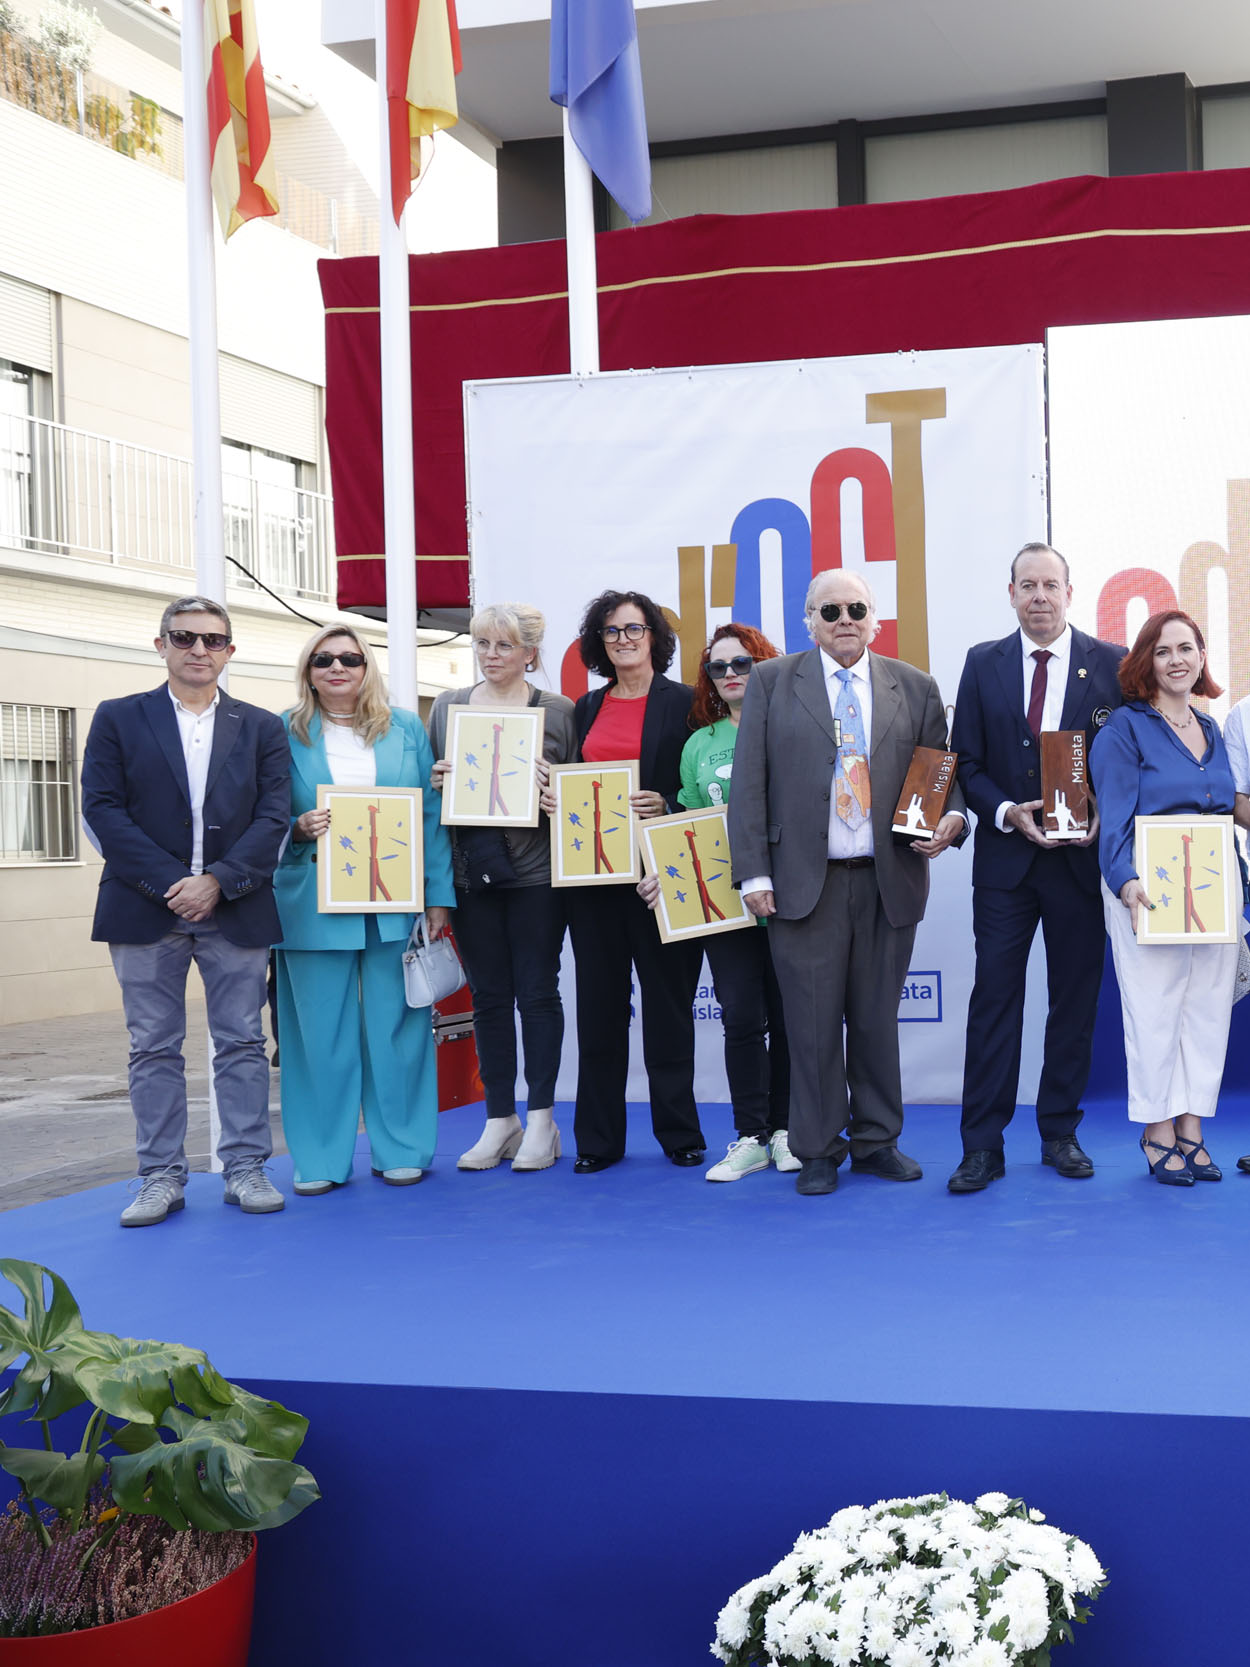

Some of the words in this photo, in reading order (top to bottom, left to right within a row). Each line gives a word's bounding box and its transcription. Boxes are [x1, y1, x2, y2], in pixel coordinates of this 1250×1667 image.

[709, 747, 736, 766] EST
[1071, 734, 1084, 783] Mislata
[932, 755, 954, 793] Mislata
[693, 1003, 723, 1020] isla
